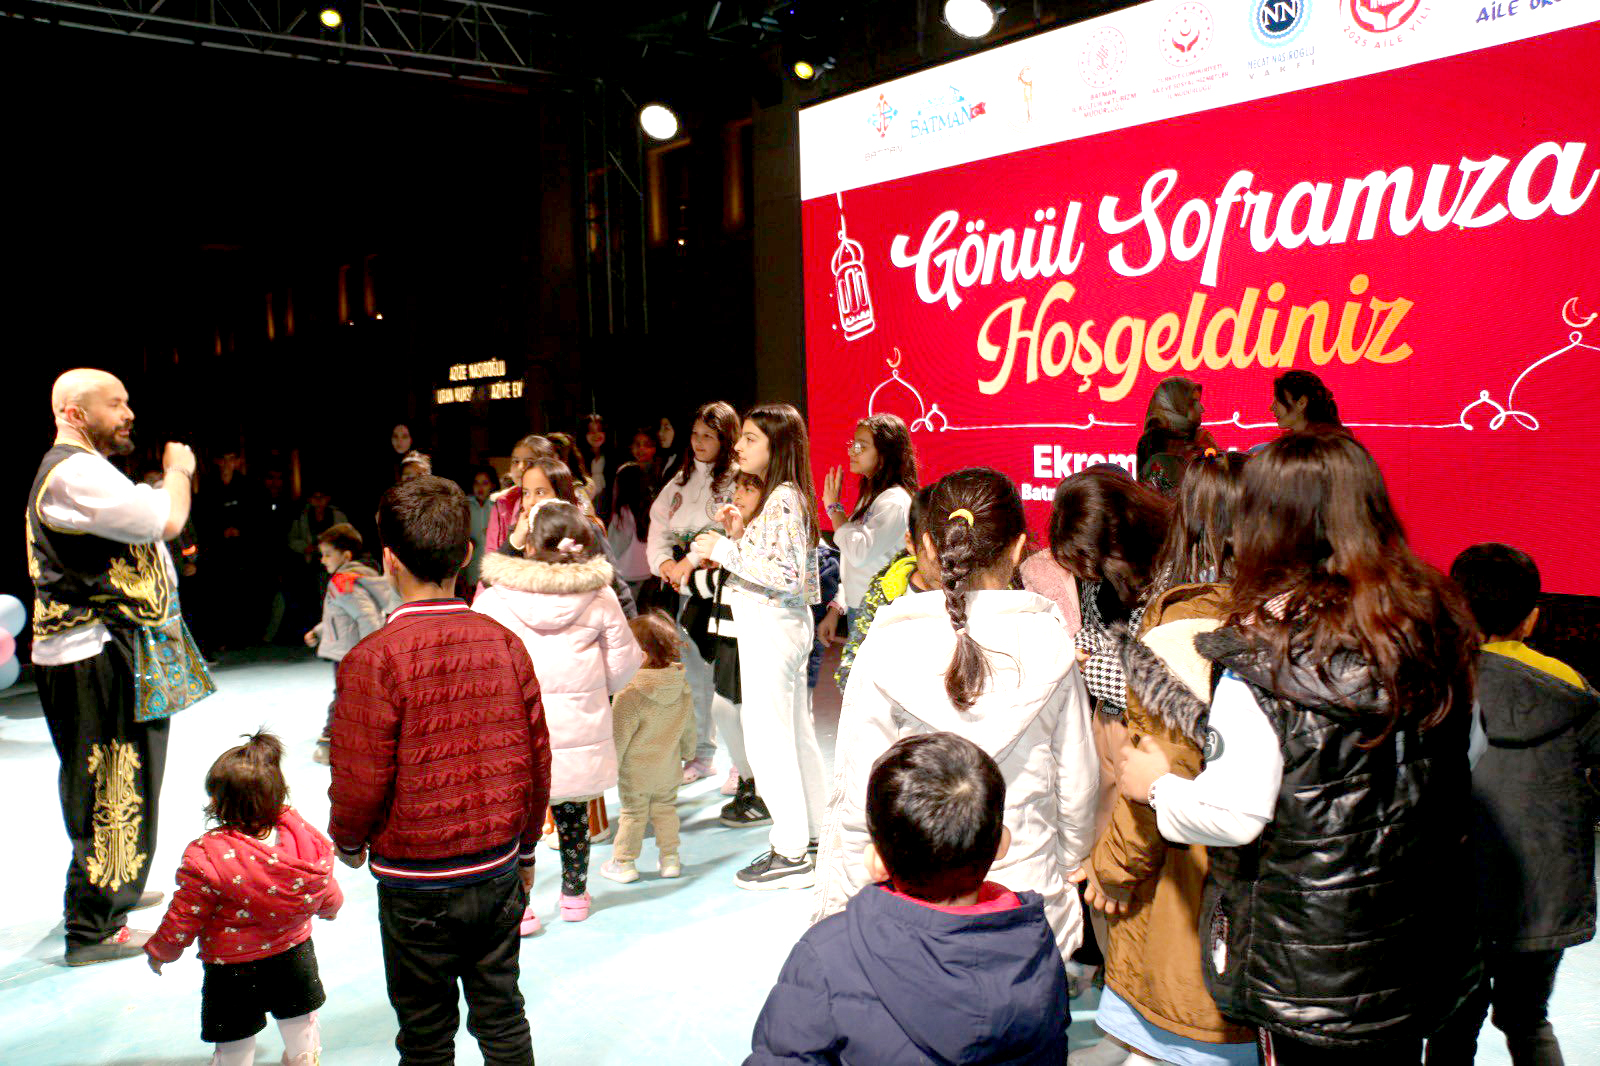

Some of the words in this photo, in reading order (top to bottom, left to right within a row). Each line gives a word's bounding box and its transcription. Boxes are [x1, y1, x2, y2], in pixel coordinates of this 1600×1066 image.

[1476, 0, 1519, 23] AİLE
[1343, 25, 1368, 47] 2025
[1374, 34, 1403, 49] AİLE
[1090, 89, 1117, 101] BATMAN
[910, 103, 973, 138] BATMAN
[891, 200, 1085, 311] Gönül
[1097, 141, 1600, 288] Soframıza
[977, 274, 1414, 403] Hoşgeldiniz
